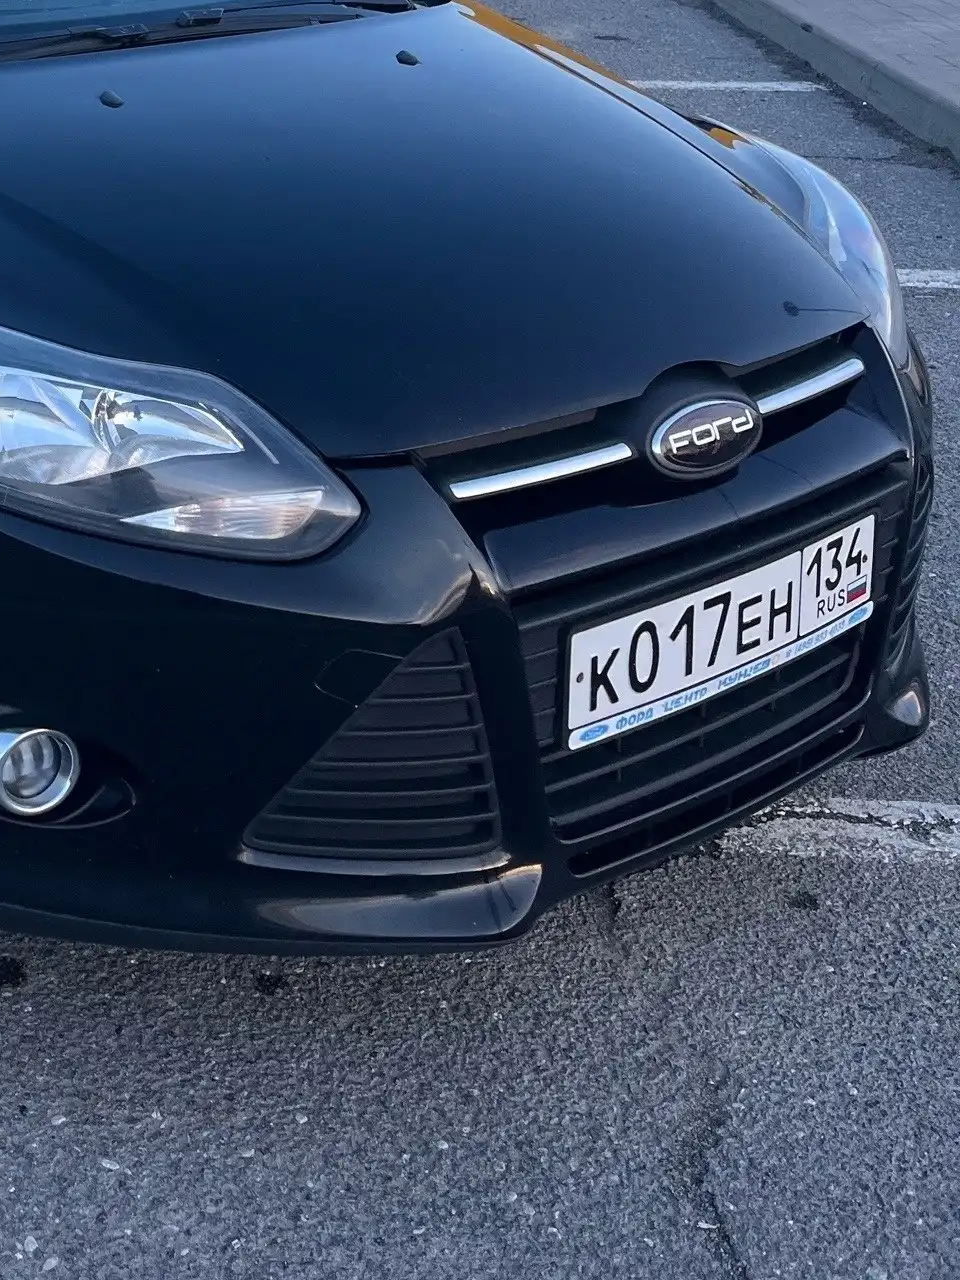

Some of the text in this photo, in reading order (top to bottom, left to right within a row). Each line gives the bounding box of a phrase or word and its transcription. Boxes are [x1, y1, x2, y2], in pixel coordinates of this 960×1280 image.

[806, 527, 864, 598] 134
[816, 588, 846, 619] RUS
[589, 581, 793, 712] К017ЕН
